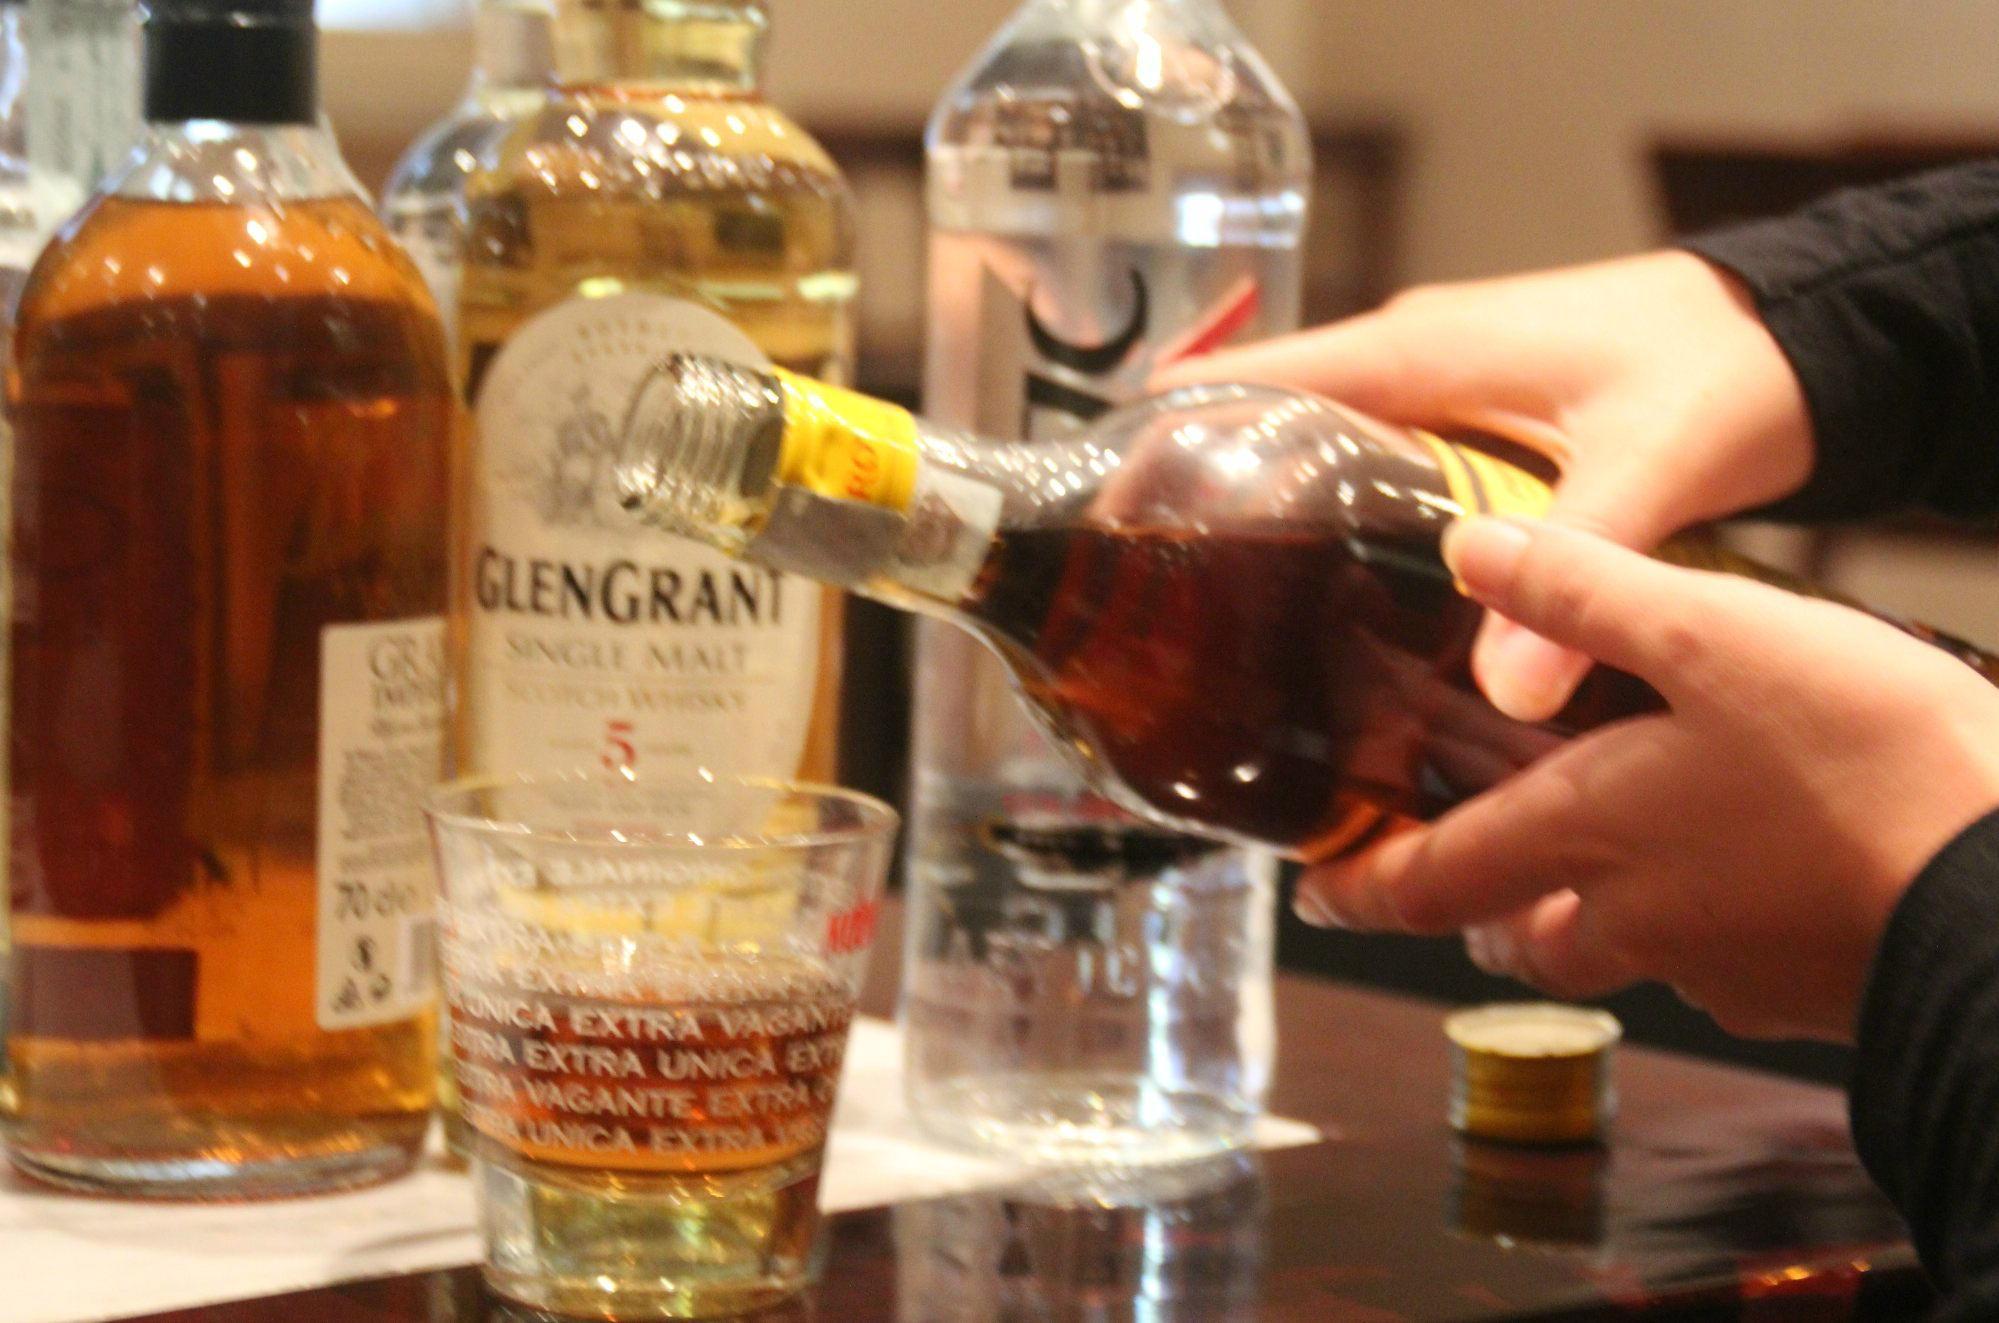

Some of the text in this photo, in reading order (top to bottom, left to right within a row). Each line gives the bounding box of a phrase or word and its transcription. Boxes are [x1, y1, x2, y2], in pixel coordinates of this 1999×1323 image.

[644, 641, 746, 674] MALT
[600, 718, 637, 769] 5
[568, 1005, 706, 1042] EXTRA
[522, 1037, 647, 1081] EXTRA
[657, 1046, 779, 1082] UNICA
[522, 1073, 697, 1122] VAGANTE
[705, 1075, 812, 1120] EXTRA
[524, 1117, 638, 1157] UNICA
